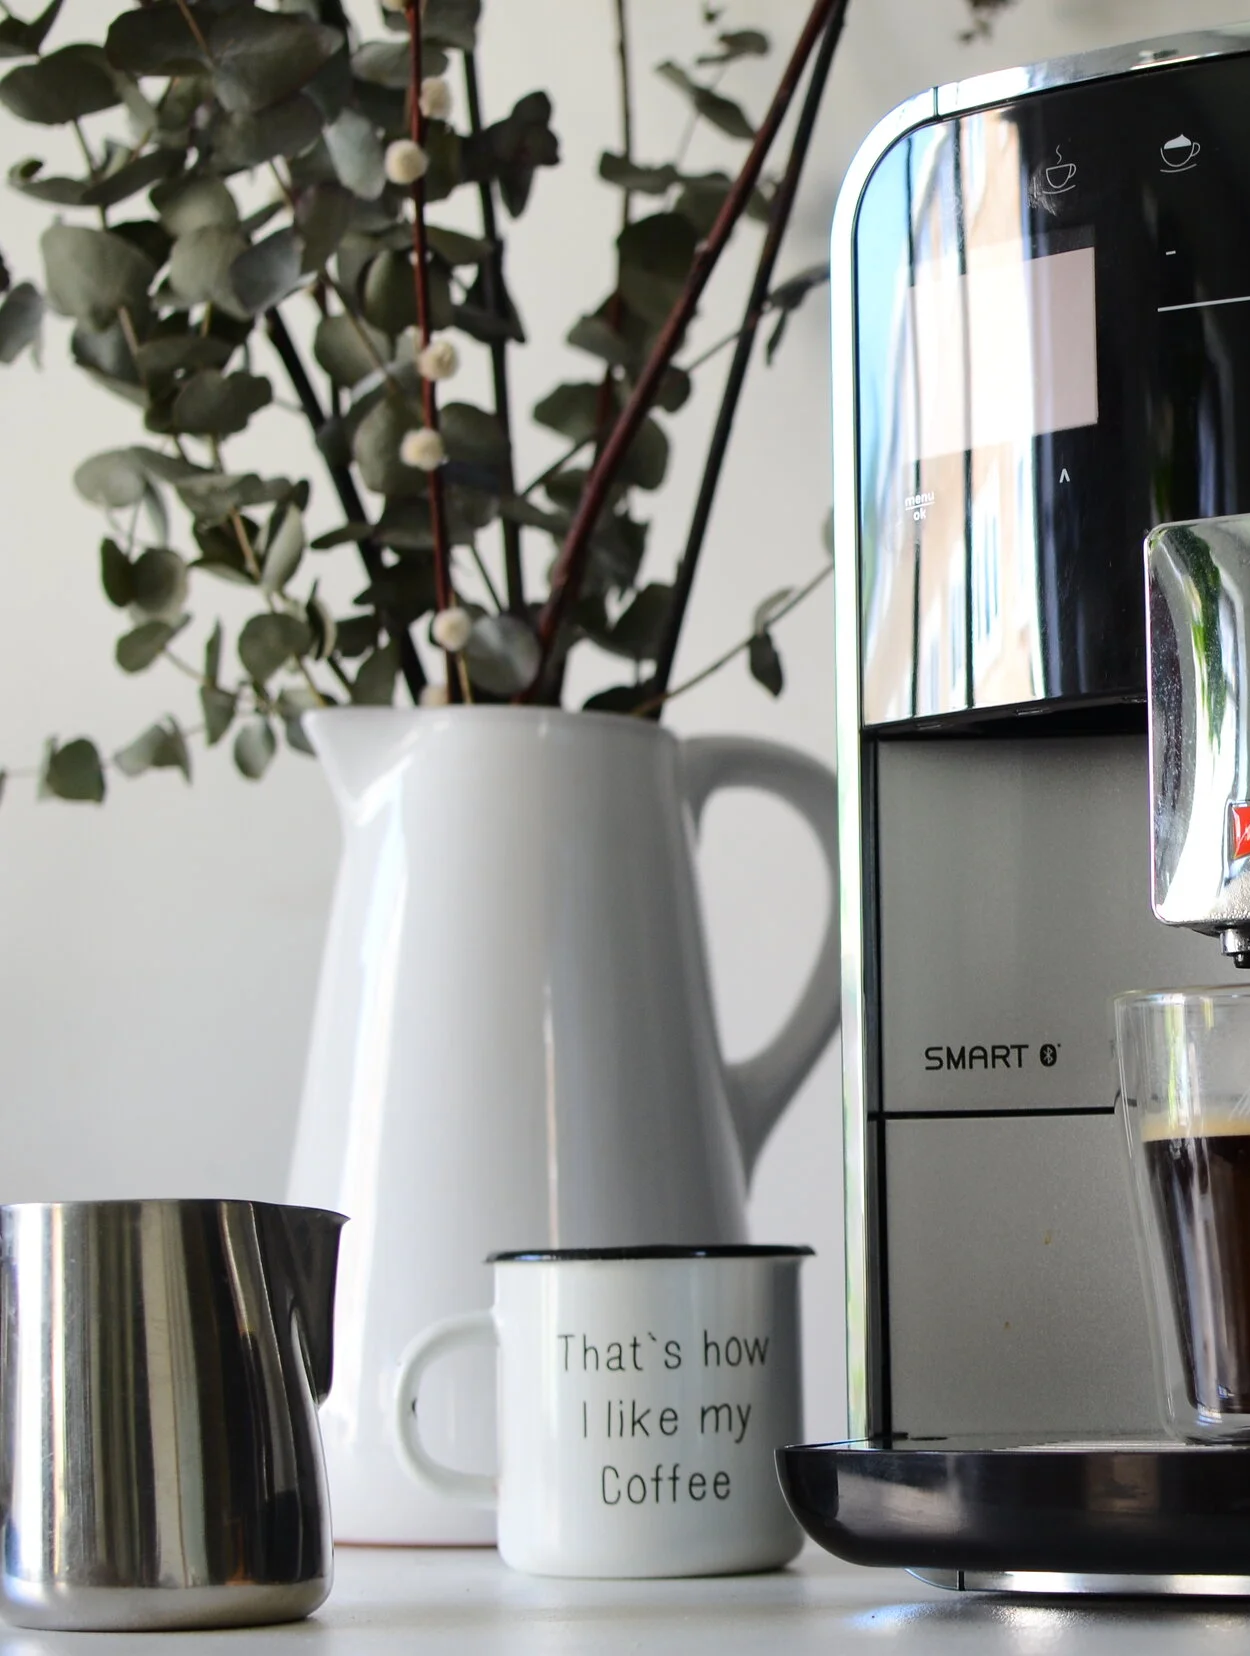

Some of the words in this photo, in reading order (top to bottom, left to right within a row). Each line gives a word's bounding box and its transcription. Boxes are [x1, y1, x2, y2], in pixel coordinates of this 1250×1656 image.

[904, 491, 935, 507] menu
[913, 507, 926, 521] ok
[924, 1044, 1029, 1071] SMART
[703, 1329, 770, 1368] how
[582, 1400, 588, 1439] I
[606, 1399, 679, 1439] like
[700, 1402, 752, 1445] my
[601, 1462, 732, 1506] Coffee
